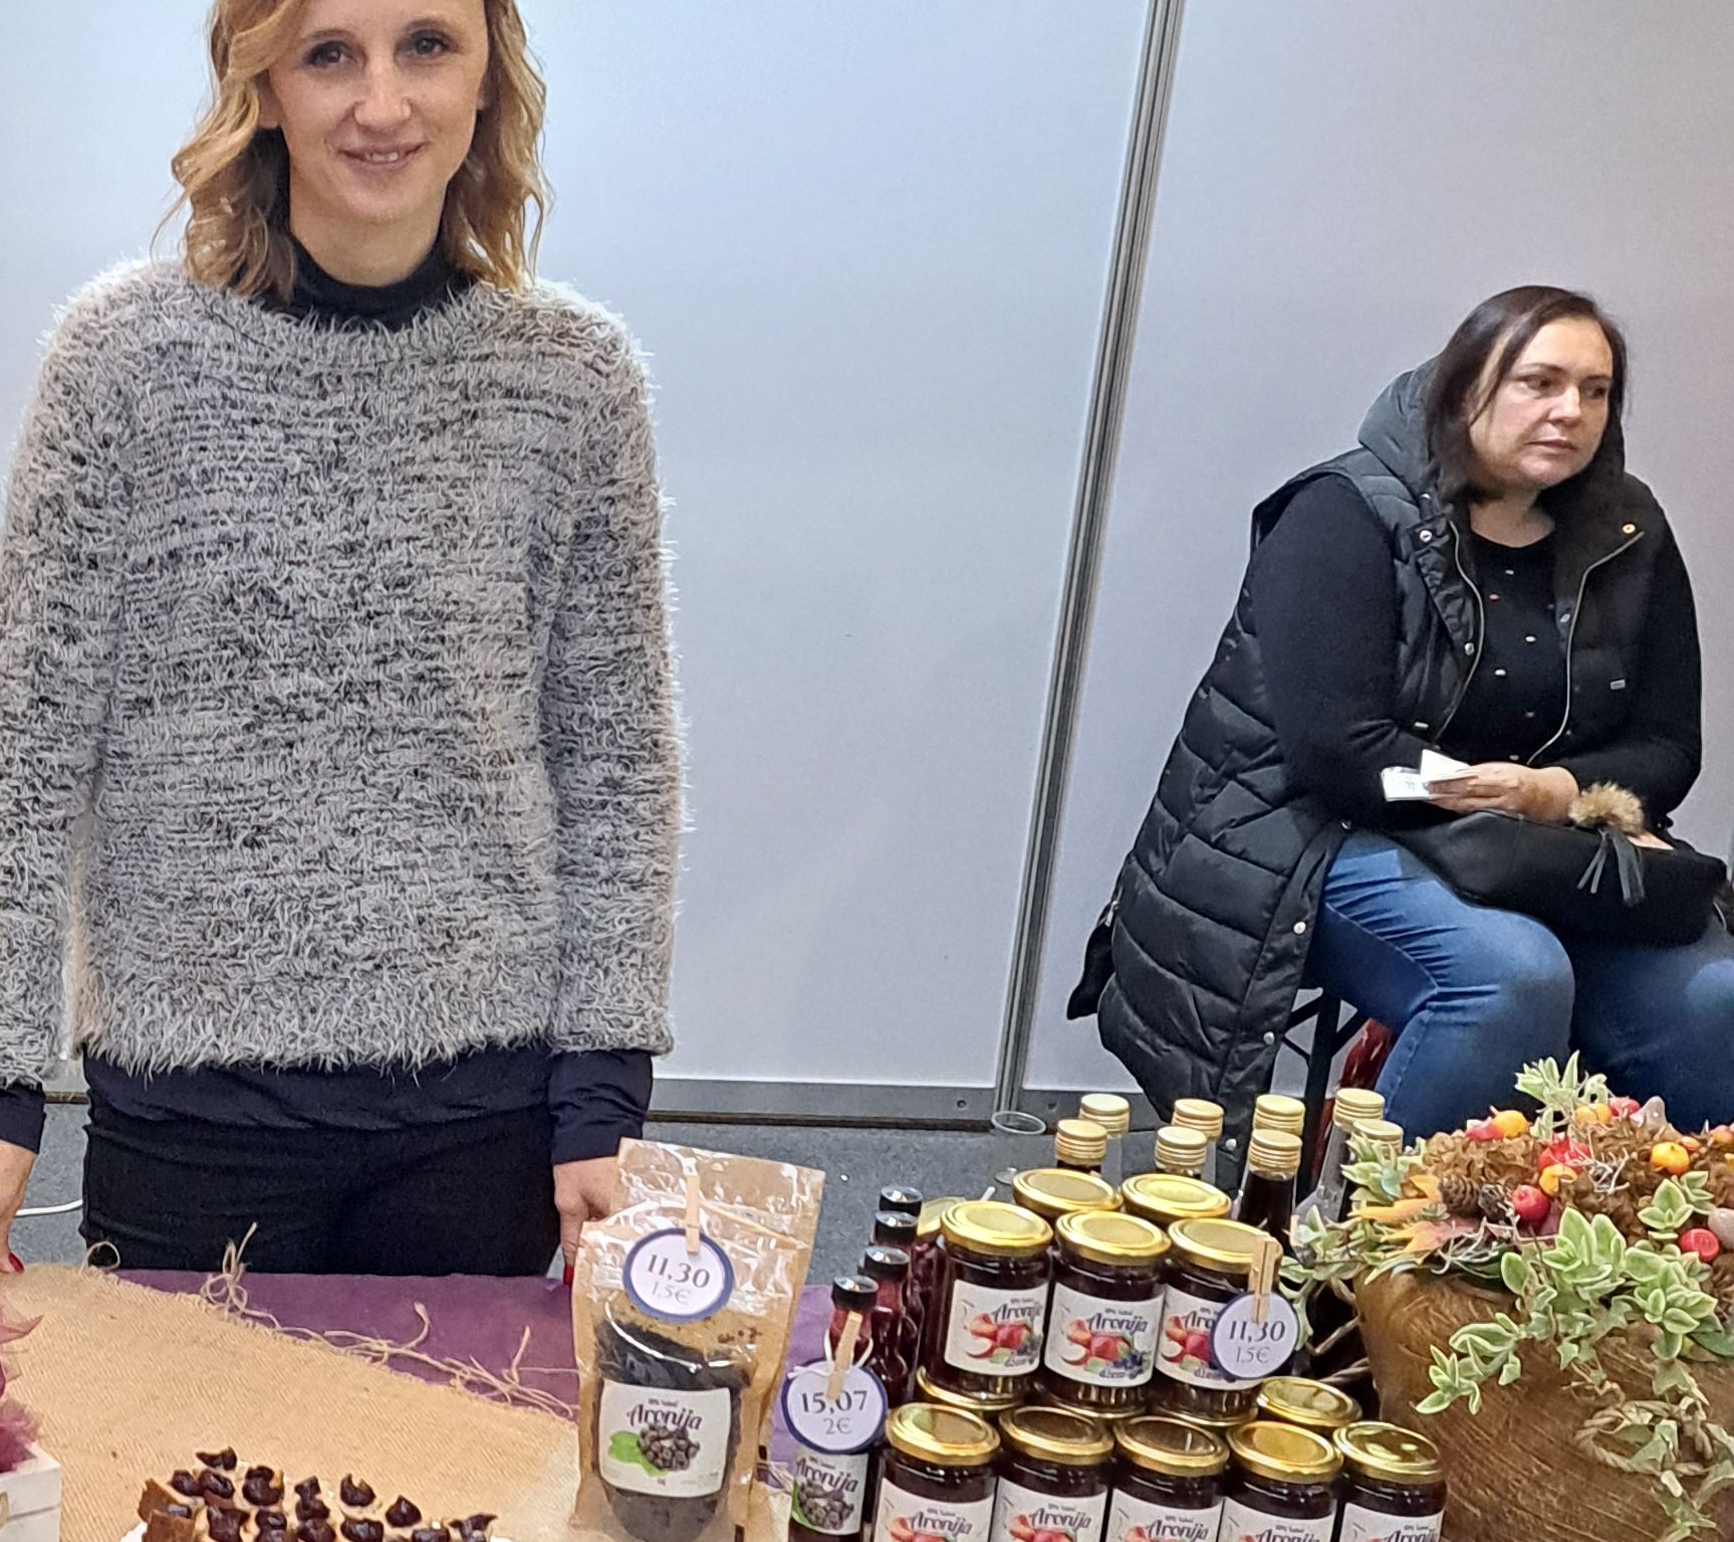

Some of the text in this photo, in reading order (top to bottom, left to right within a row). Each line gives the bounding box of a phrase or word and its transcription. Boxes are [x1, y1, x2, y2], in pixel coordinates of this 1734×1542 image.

[647, 1254, 711, 1289] 11,30
[1086, 1312, 1149, 1335] Aronija
[801, 1389, 869, 1415] 15,07
[626, 1403, 703, 1435] Aronija
[823, 1417, 853, 1436] 2€
[796, 1456, 859, 1493] Aronija
[907, 1510, 974, 1536] Aronija
[1029, 1507, 1092, 1532] Aronija
[1144, 1519, 1210, 1542] Aronija
